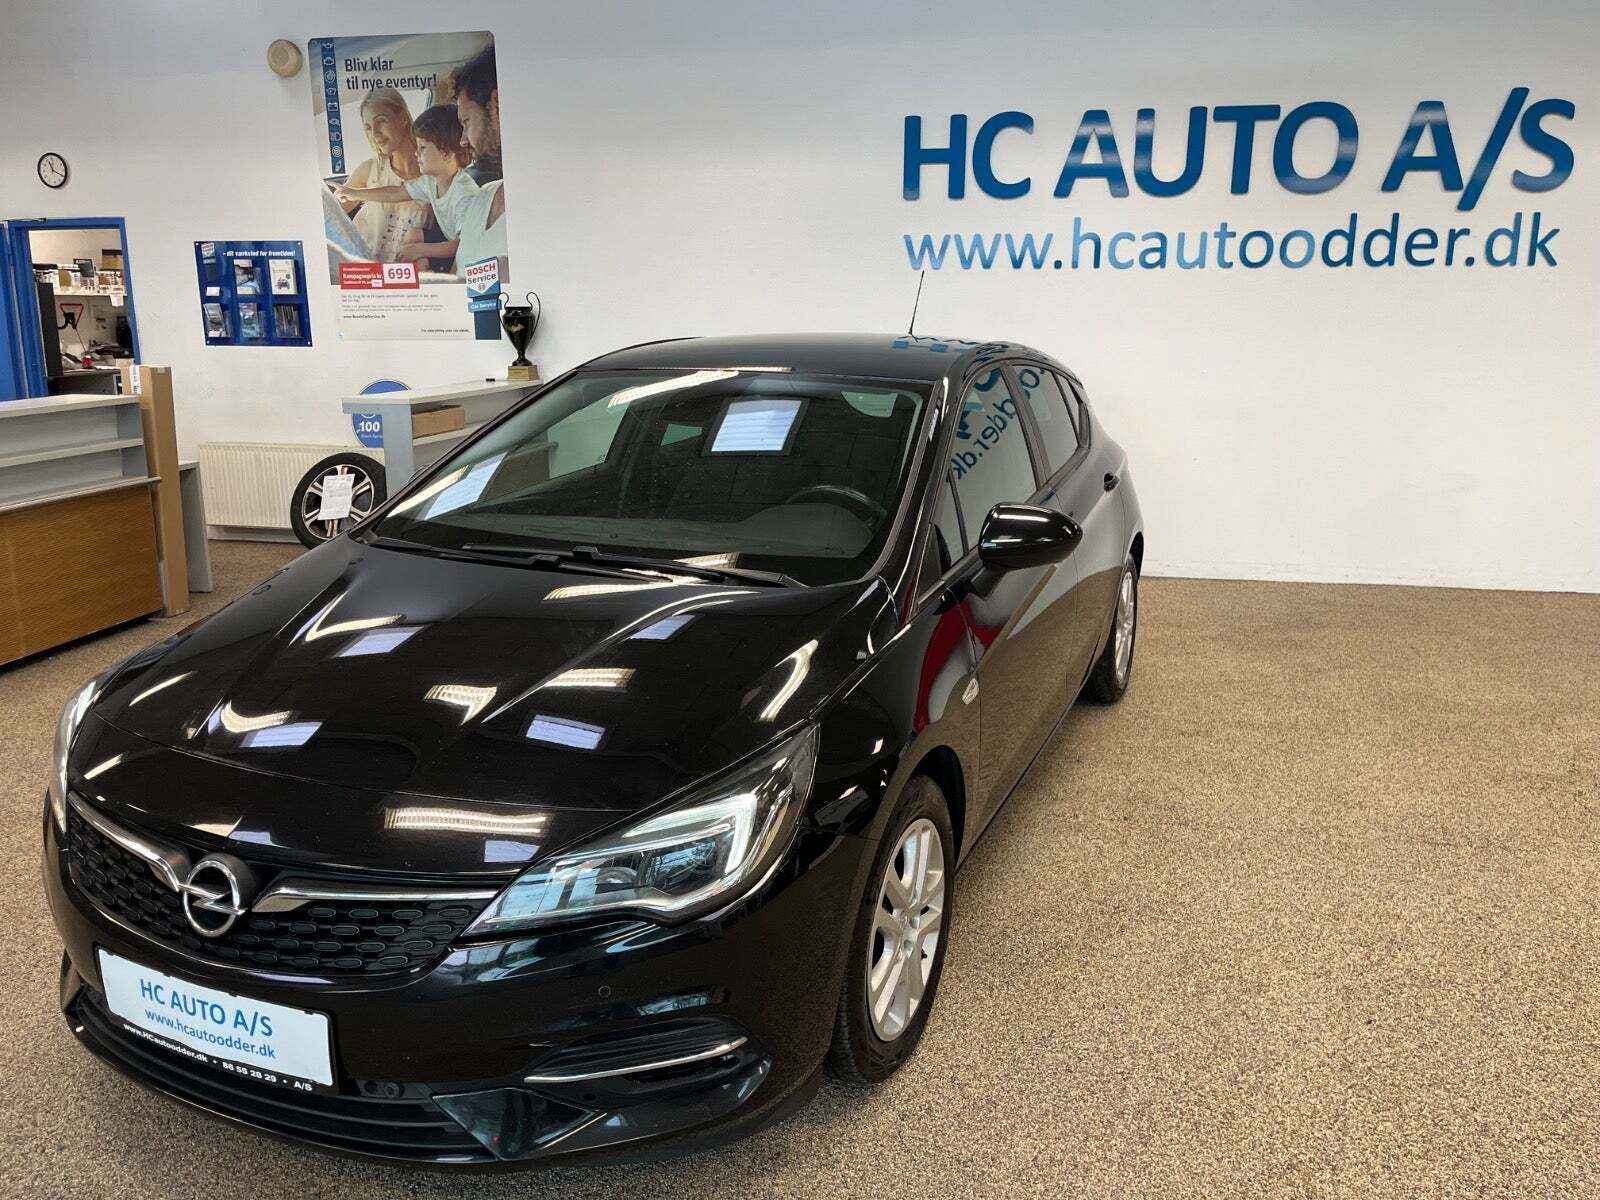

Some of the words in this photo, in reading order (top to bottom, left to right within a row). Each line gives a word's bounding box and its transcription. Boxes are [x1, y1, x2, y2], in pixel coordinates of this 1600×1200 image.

[345, 58, 368, 72] Bliv
[370, 56, 394, 71] klar
[346, 75, 359, 90] til
[362, 78, 383, 92] nye
[386, 73, 437, 91] eventyr!
[902, 110, 1035, 200] HC
[1053, 100, 1360, 198] AUTO
[1380, 86, 1576, 212] A/S
[902, 211, 1561, 271] www.hcautoodder.dk
[388, 267, 411, 280] 699
[466, 262, 496, 277] BOSCH
[467, 273, 497, 285] Service
[359, 421, 380, 432] 100
[139, 977, 166, 1006] HC
[170, 989, 227, 1026] AUTO
[232, 1009, 274, 1037] A/S
[144, 1008, 277, 1060] www.hcautoodder.dk
[250, 1069, 263, 1079] 28
[293, 1080, 314, 1092] A/S
